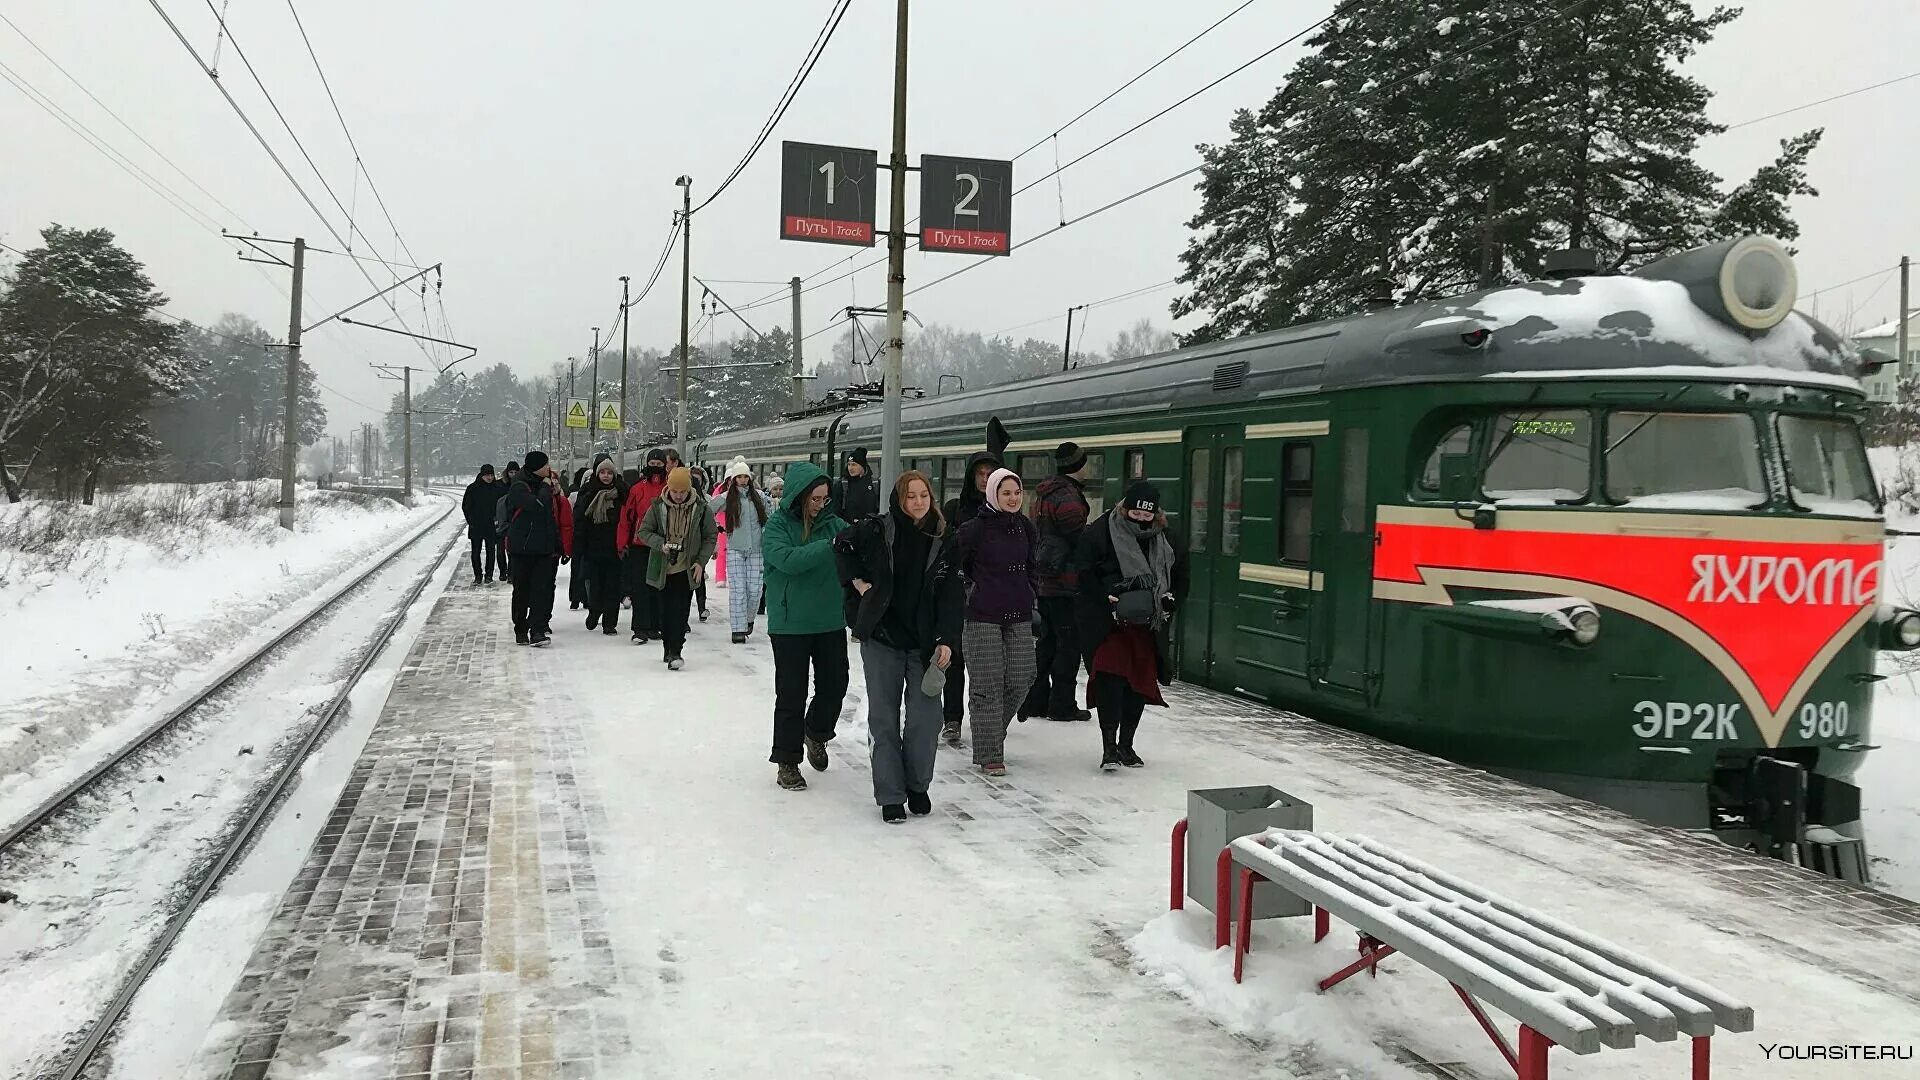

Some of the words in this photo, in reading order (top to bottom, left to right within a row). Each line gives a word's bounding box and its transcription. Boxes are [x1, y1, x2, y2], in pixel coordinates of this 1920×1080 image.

[819, 161, 835, 204] 1
[954, 173, 979, 216] 2
[796, 219, 828, 234] Путь
[837, 225, 863, 237] Track
[935, 231, 965, 246] Путь
[973, 236, 998, 247] Track
[1136, 499, 1154, 511] LBS
[1631, 700, 1740, 740] ЭР2К
[1799, 701, 1849, 739] 980
